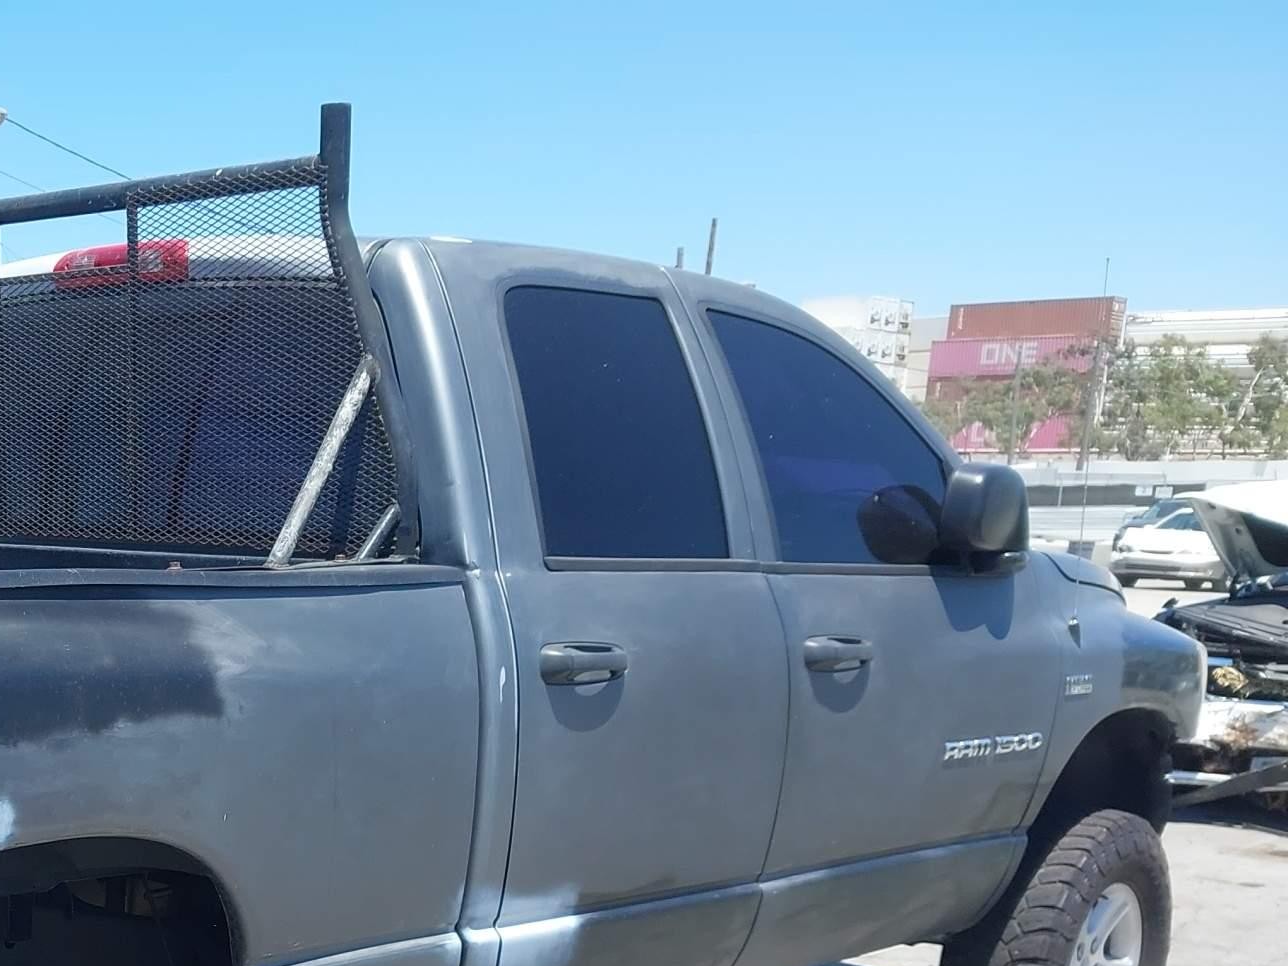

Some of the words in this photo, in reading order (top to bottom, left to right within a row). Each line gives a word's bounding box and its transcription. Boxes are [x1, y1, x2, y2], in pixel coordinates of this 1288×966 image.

[980, 341, 1038, 364] ONE
[944, 737, 992, 760] RAM
[994, 732, 1045, 754] 1500
